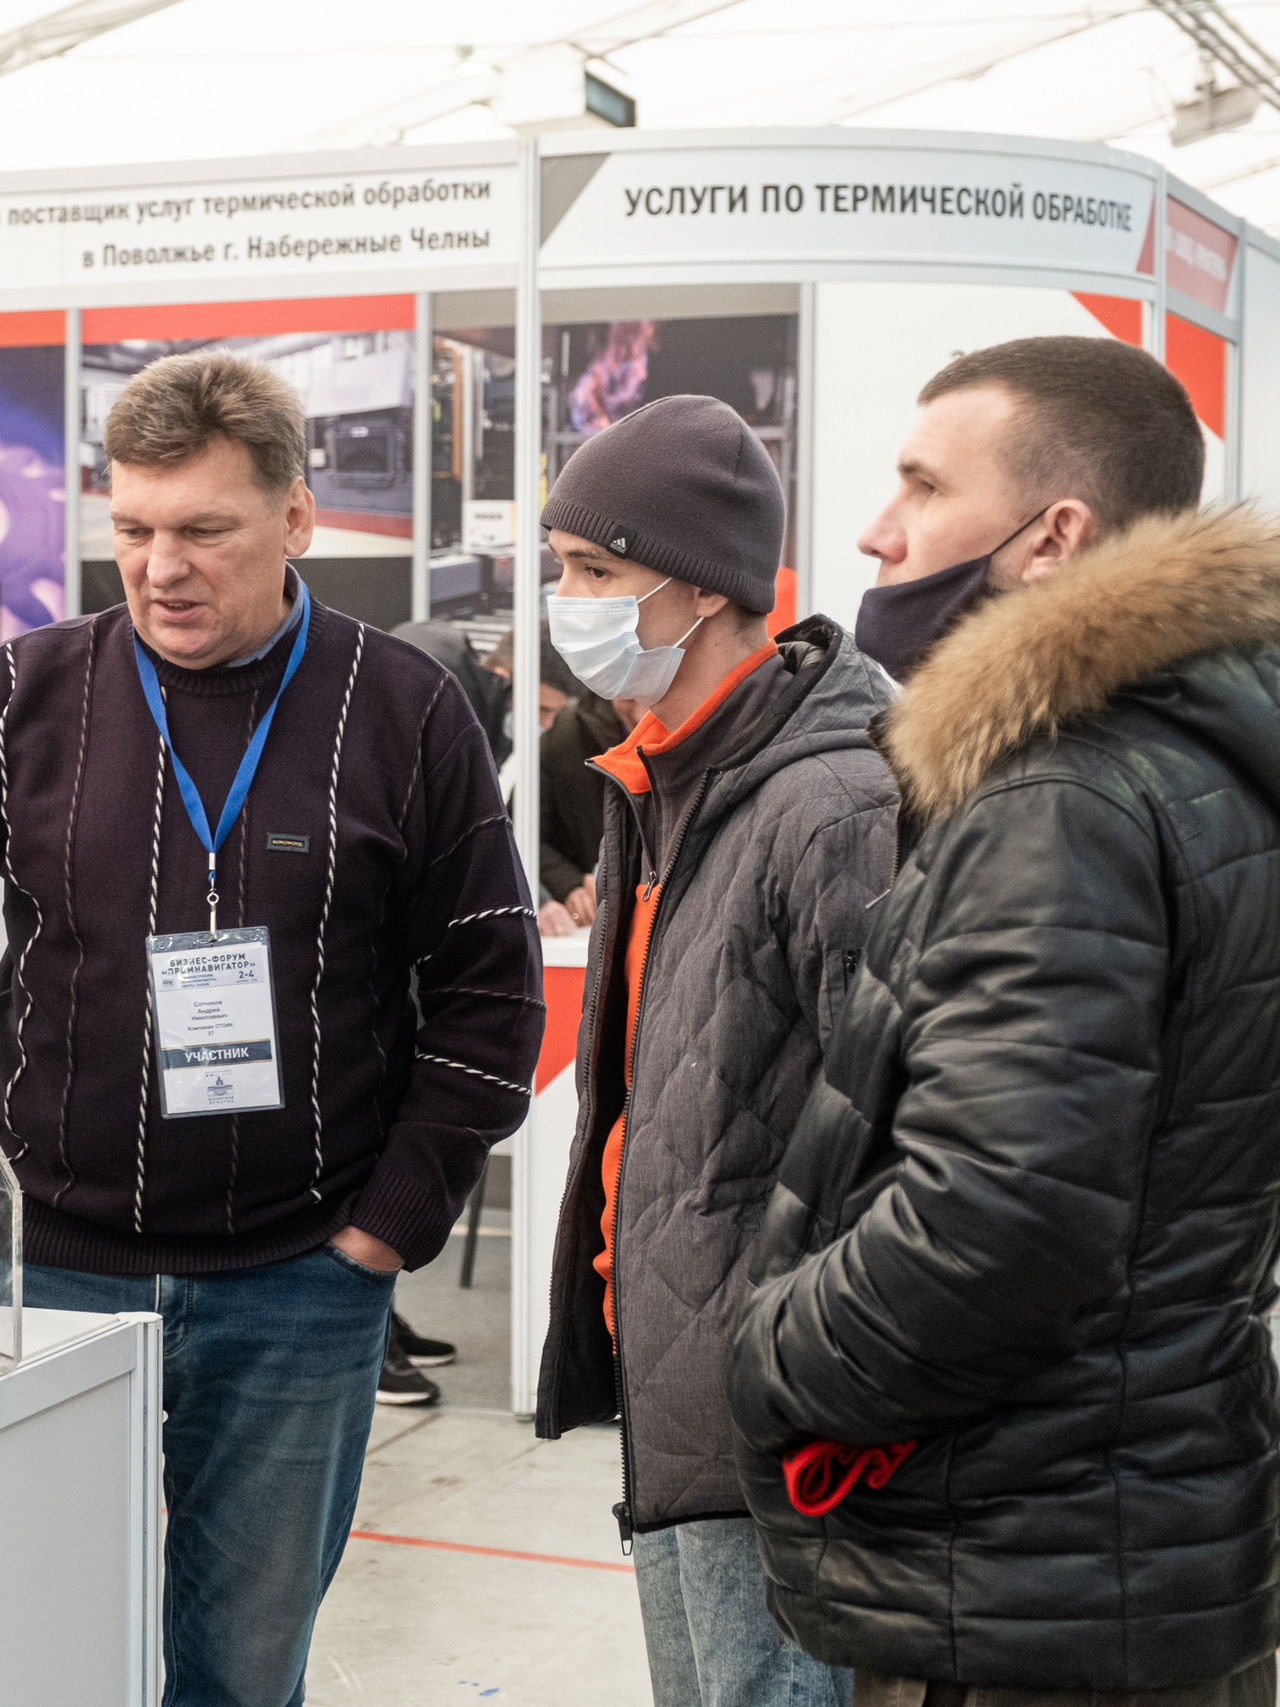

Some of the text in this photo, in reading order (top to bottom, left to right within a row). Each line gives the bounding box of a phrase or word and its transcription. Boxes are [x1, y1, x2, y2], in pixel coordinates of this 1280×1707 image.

[8, 199, 130, 227] поставщик
[136, 195, 195, 224] услуг
[202, 183, 356, 214] термической
[363, 177, 492, 206] обработки
[624, 181, 1133, 233] УСЛУГИ ПО ТЕРМИЧЕСКОЙ ОБРАБОТКЕ
[82, 225, 492, 268] в Поволжье г. Набережные Челны
[170, 953, 246, 967] БИЗНЕС-ФОРУМ
[161, 961, 256, 976] «ПРОМНАВИГАТОР»
[238, 969, 255, 979] 2-4
[184, 1047, 250, 1063] УЧАСТНИК
